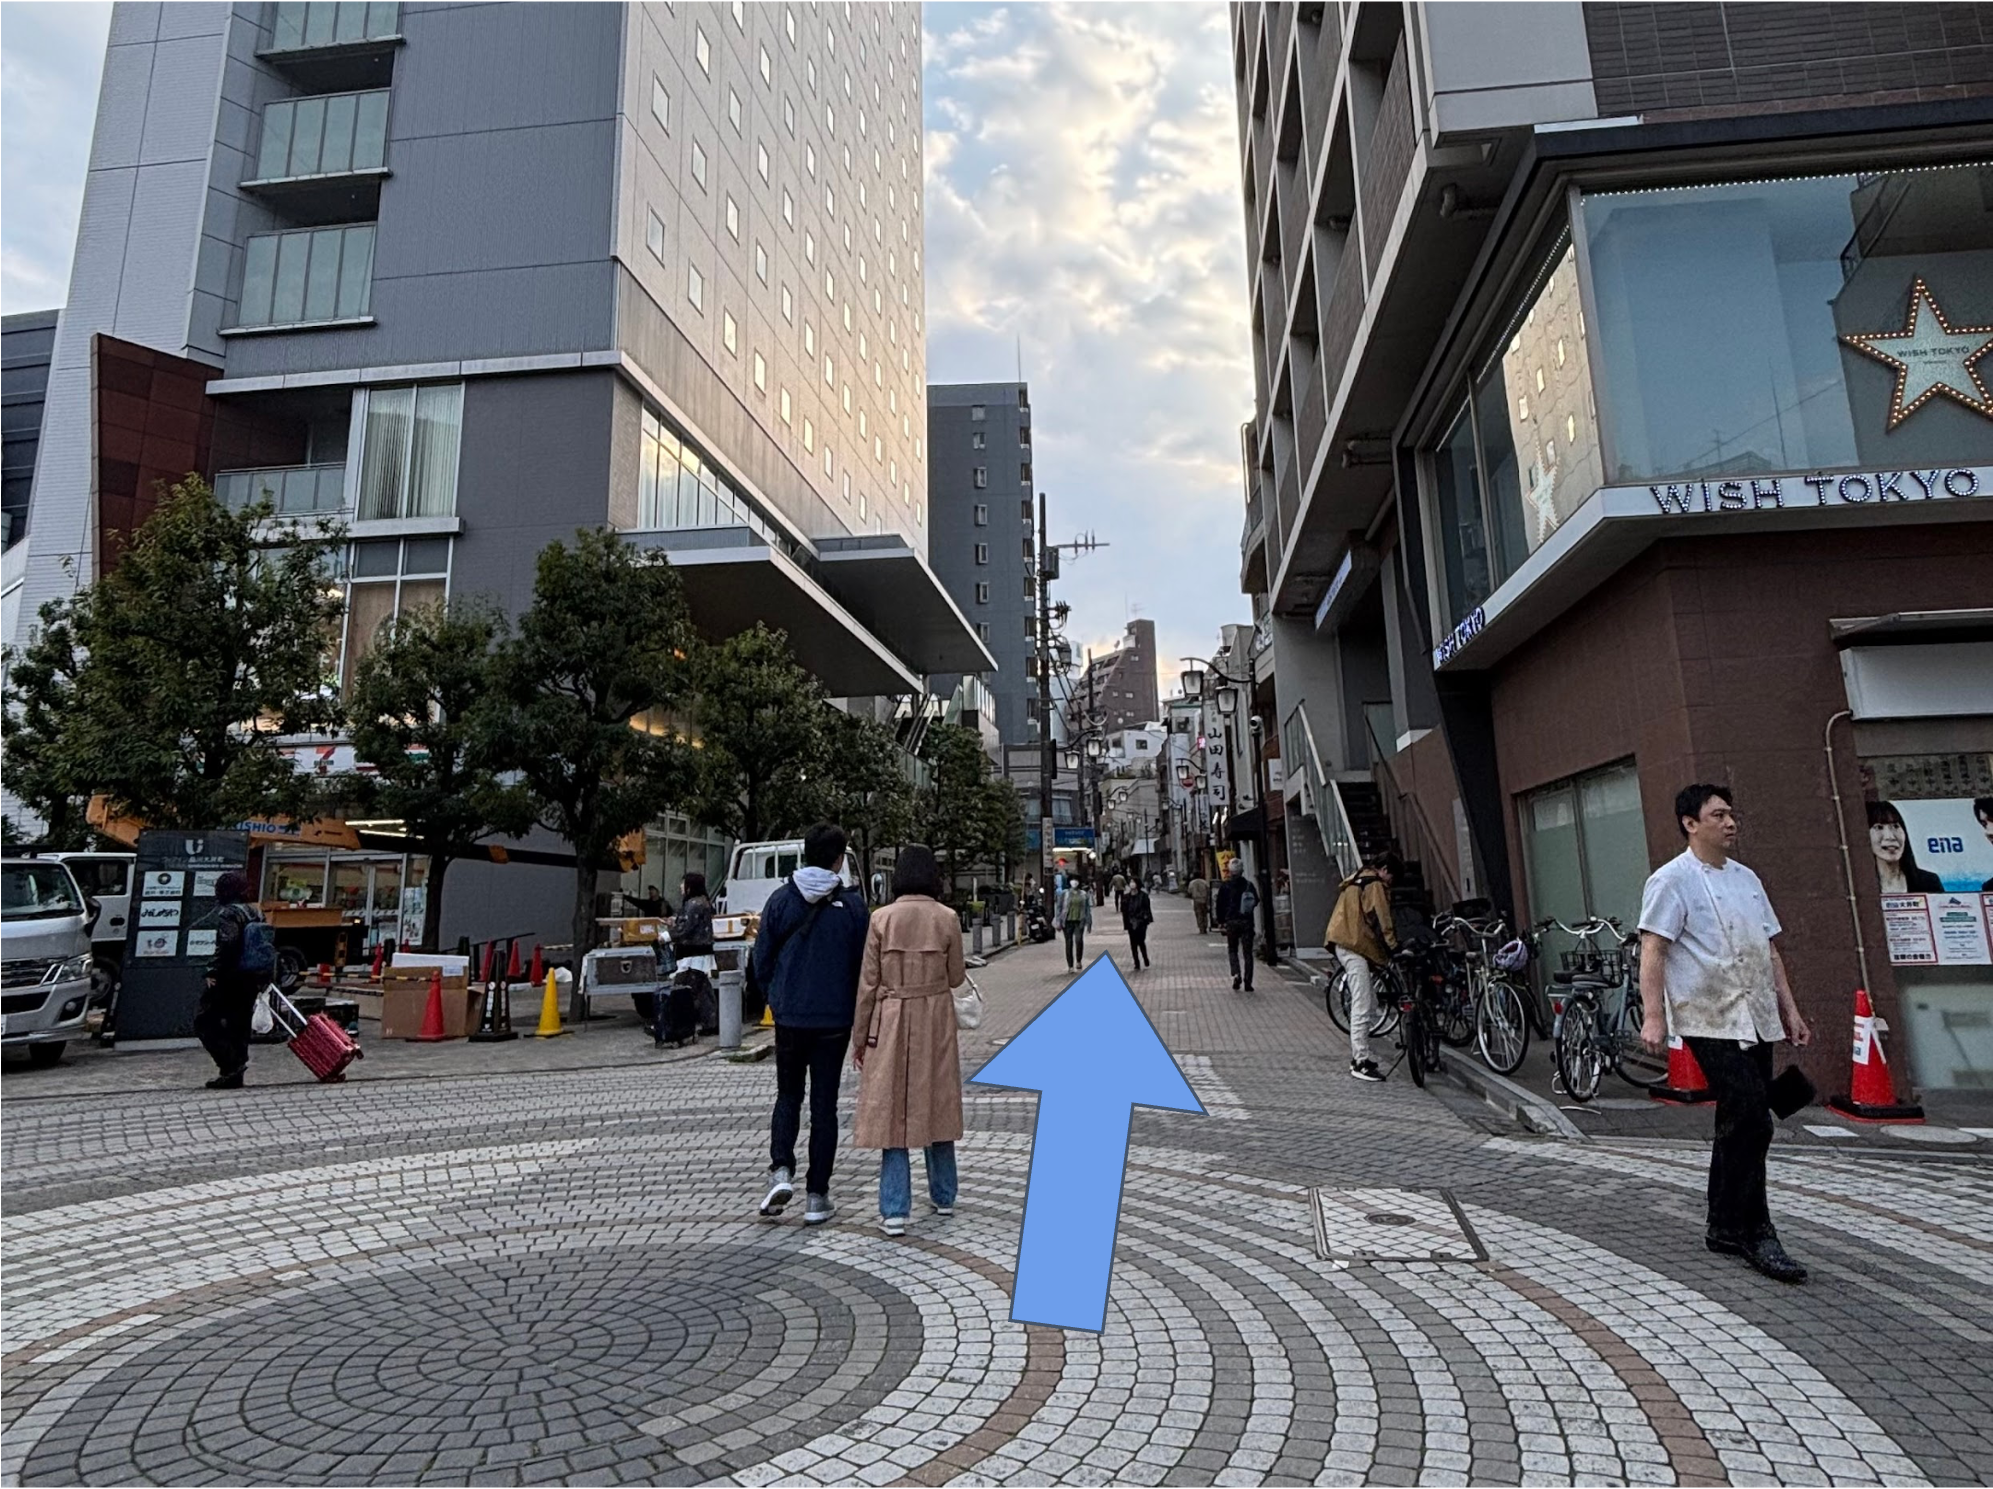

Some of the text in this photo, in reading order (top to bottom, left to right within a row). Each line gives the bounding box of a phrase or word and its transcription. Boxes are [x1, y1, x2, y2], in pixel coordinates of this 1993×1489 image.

[1931, 346, 1969, 356] TOKYO
[1650, 468, 1979, 514] WISH TOKYO
[1207, 727, 1226, 801] 山田寿司
[1928, 836, 1964, 853] ena
